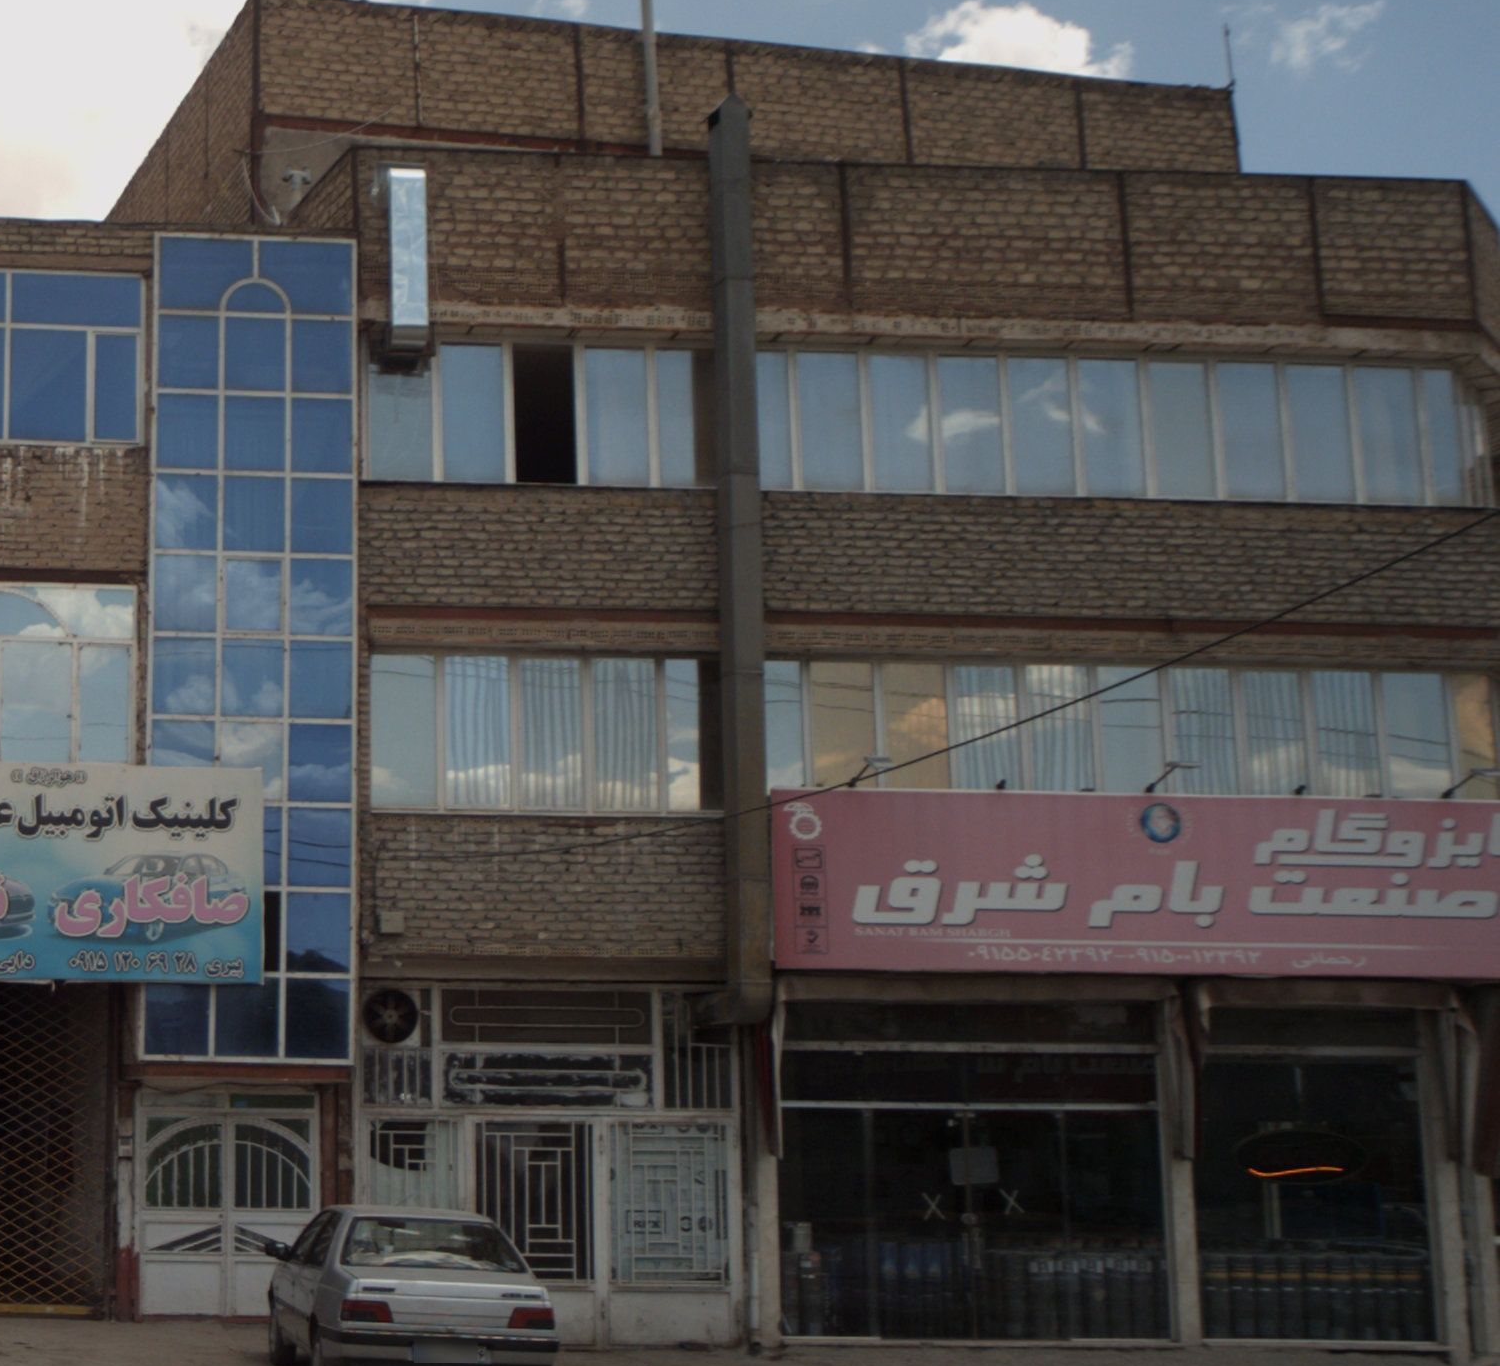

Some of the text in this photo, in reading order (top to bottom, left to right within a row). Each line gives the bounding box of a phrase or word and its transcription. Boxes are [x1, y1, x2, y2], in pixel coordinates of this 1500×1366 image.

[16, 792, 126, 839] اتومبیل
[132, 795, 238, 840] کلینیک
[54, 872, 250, 940] صافکاری
[851, 853, 1498, 929] صنعت بام شرق
[854, 927, 906, 936] SANAT
[69, 950, 108, 973] ۰۹۱۵
[1291, 951, 1367, 969] رحمانی
